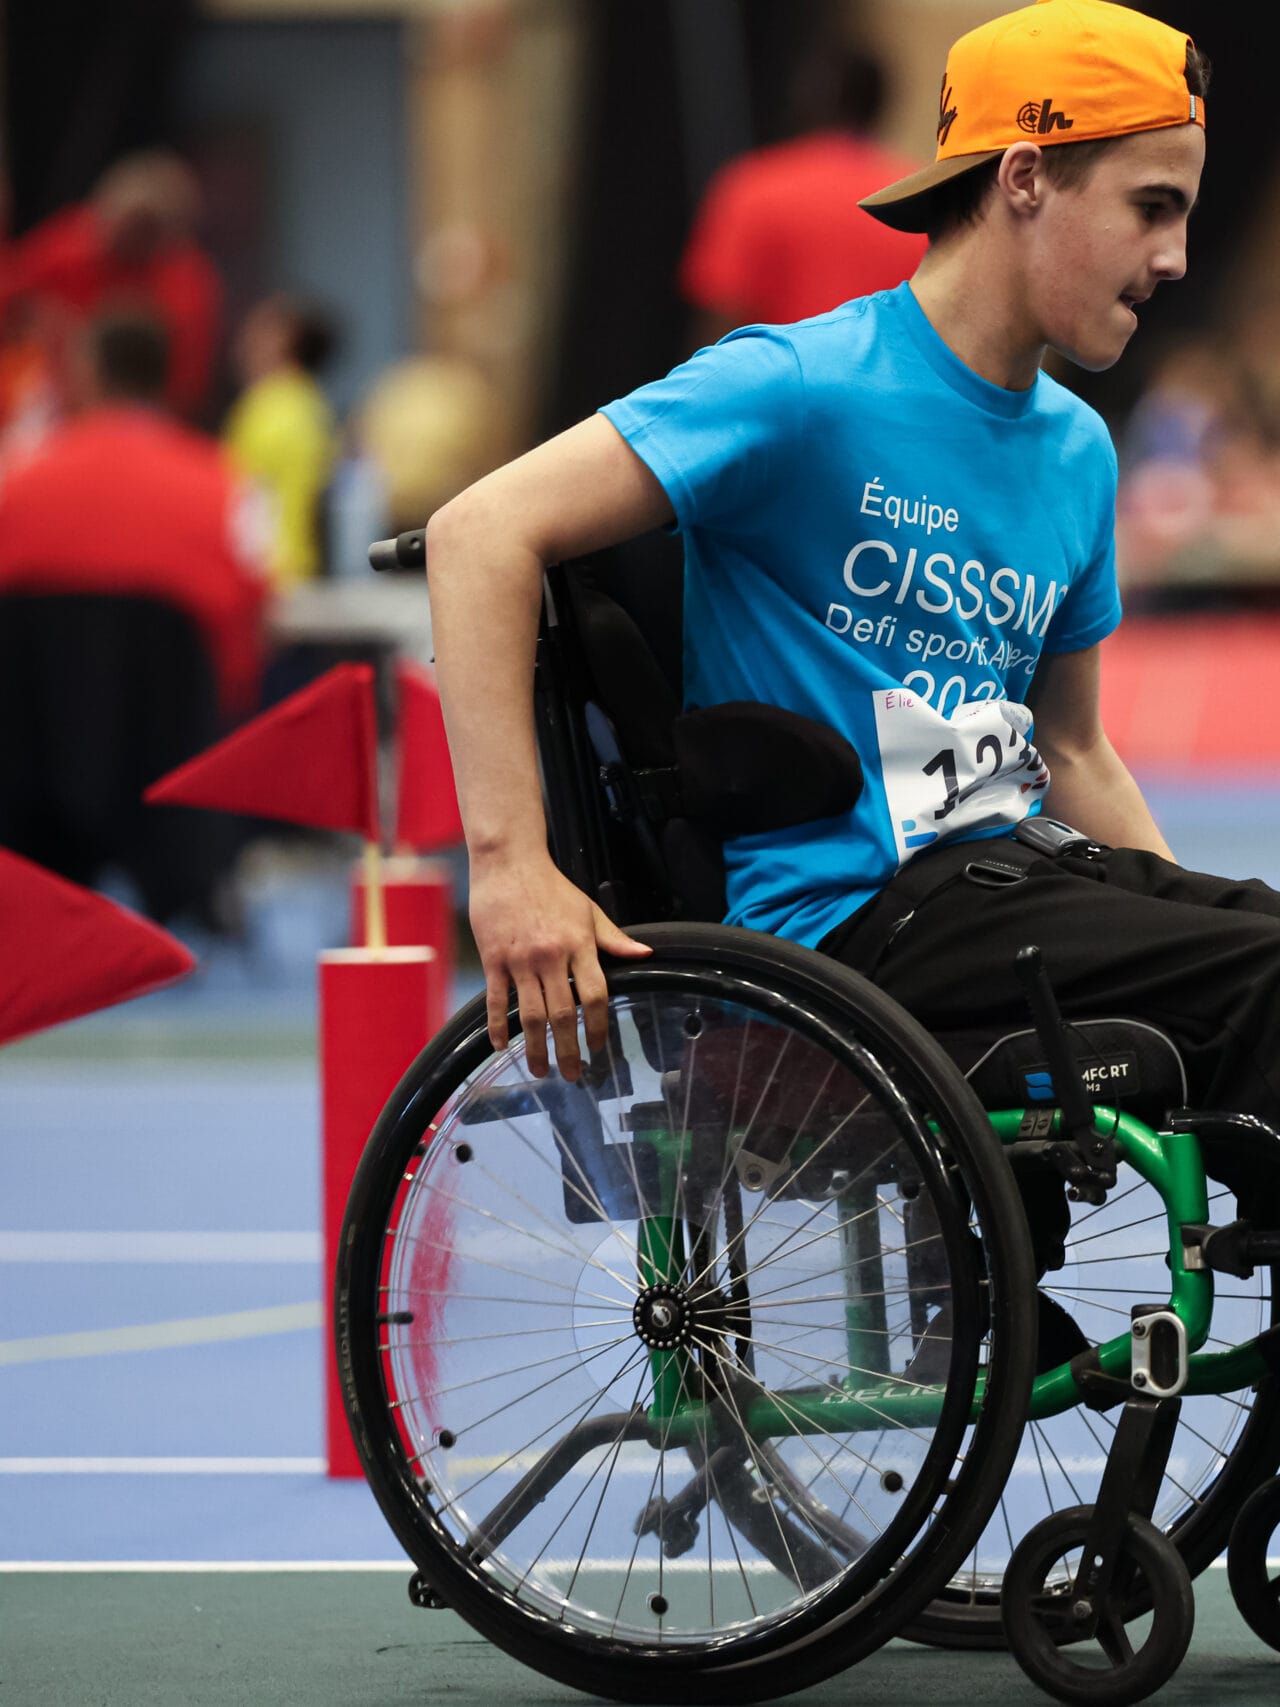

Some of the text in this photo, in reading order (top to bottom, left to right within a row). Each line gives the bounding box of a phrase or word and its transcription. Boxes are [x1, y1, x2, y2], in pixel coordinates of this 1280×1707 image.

[860, 477, 959, 535] Équipe
[825, 602, 897, 647] Defi
[885, 691, 915, 710] Élie
[902, 669, 1007, 719] 202
